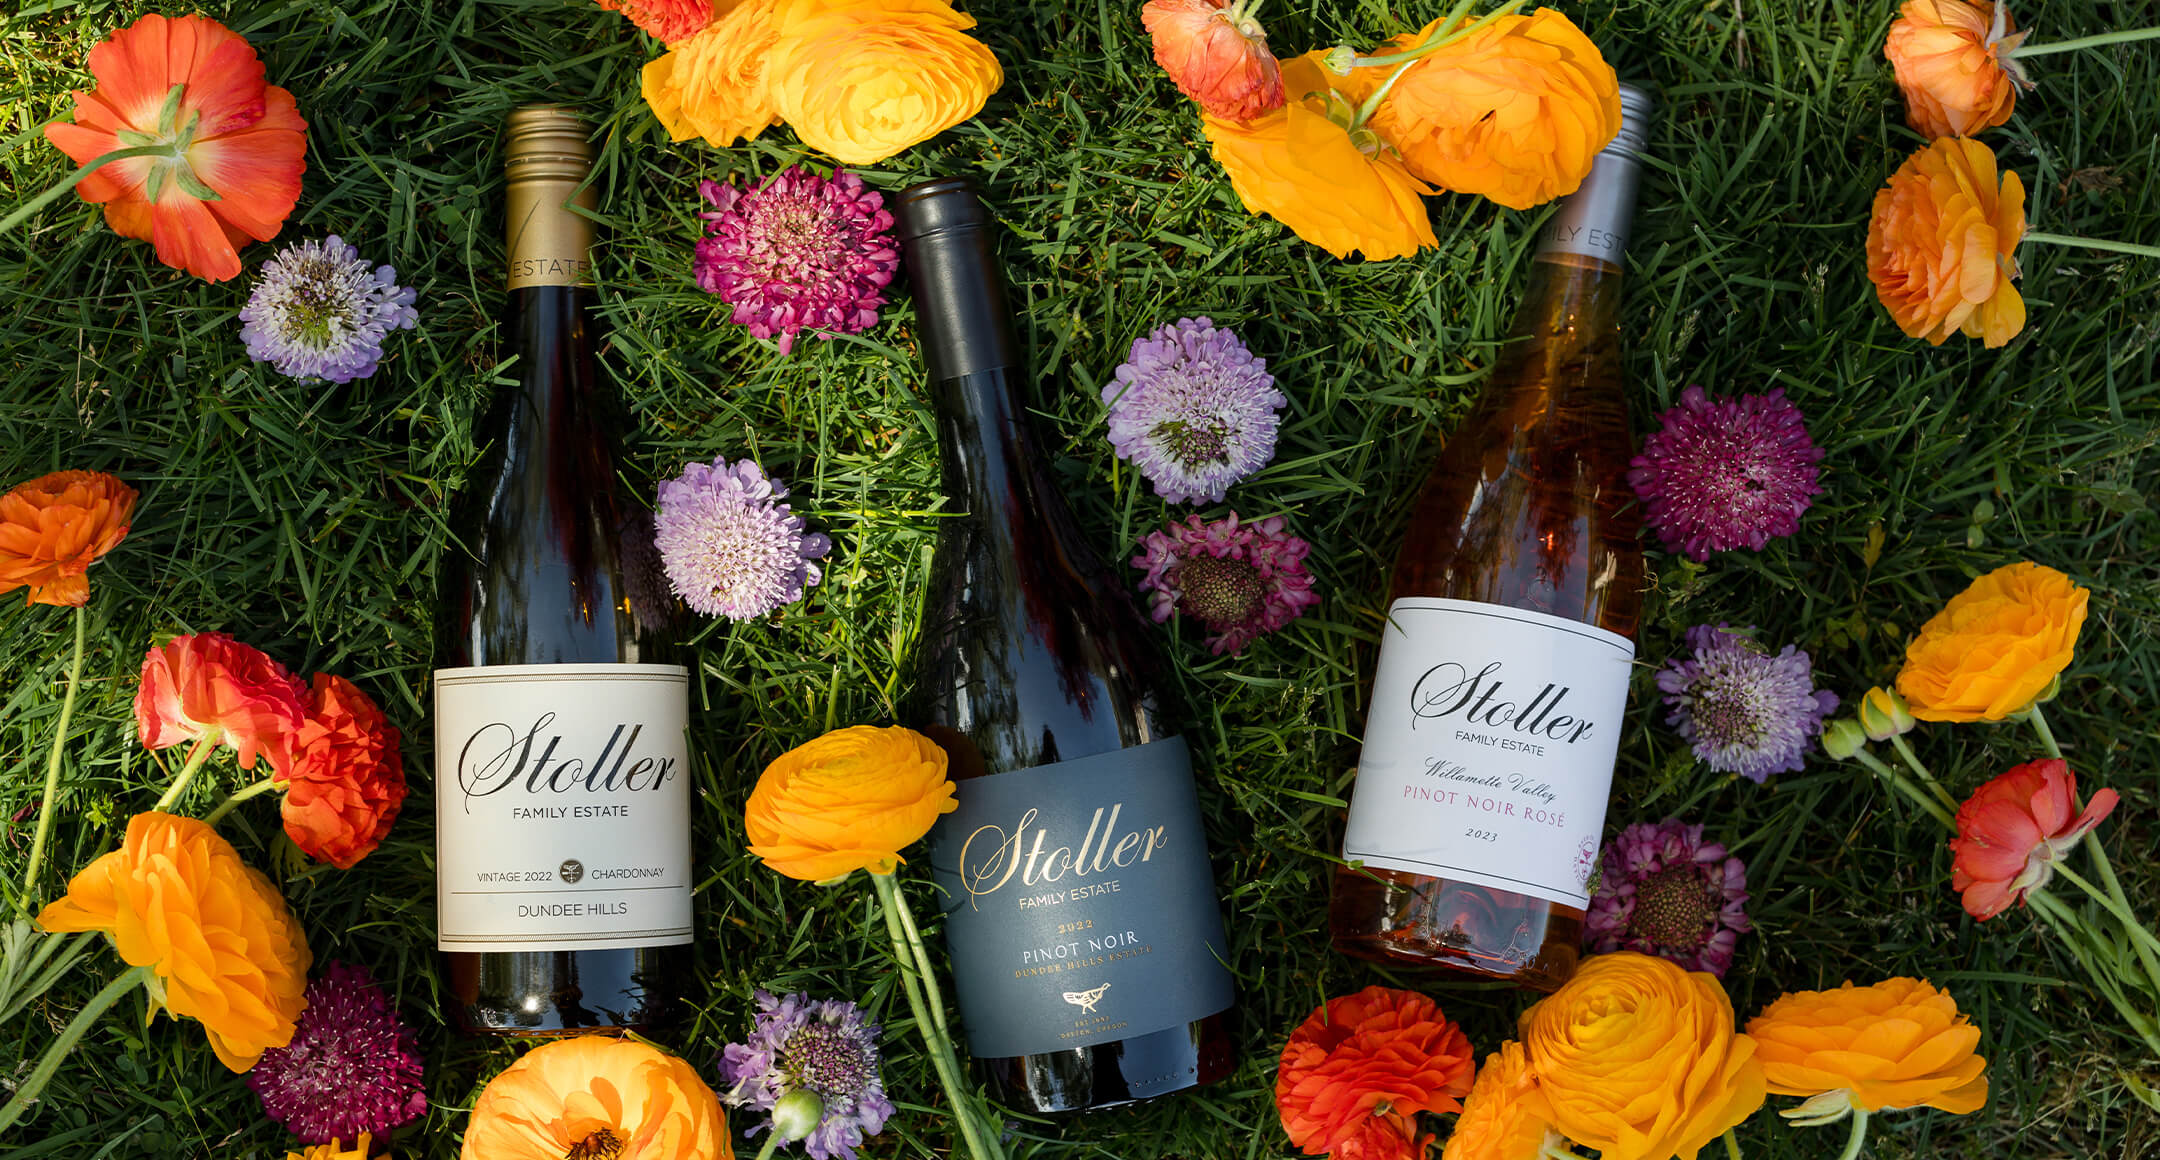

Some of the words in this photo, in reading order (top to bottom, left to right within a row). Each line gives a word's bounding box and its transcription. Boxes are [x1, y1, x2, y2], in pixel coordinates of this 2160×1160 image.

[1410, 661, 1593, 745] Stoller
[1455, 730, 1498, 750] FAMILY
[1502, 739, 1545, 757] ESTATE
[458, 711, 676, 815] Stoller
[1424, 755, 1503, 789] Willamette
[1507, 772, 1557, 805] Valley
[513, 806, 568, 819] FAMILY
[574, 805, 629, 818] ESTATE
[1403, 785, 1458, 805] PINOT
[1467, 794, 1515, 817] NOIR
[1524, 806, 1566, 828] ROSÉ
[1465, 827, 1499, 843] 2023
[591, 867, 665, 880] CHARDONNAY
[959, 802, 1168, 912] Stoller
[477, 871, 521, 883] VINTAGE
[524, 871, 552, 882] 2022
[518, 903, 583, 918] DUNDEE
[588, 902, 628, 916] HILLS
[1019, 891, 1066, 912] FAMILY
[1071, 879, 1121, 901] ESTATE
[1057, 919, 1094, 934] 2022
[1015, 963, 1062, 979] DUNDEE
[1067, 955, 1105, 971] HILLS
[1109, 945, 1153, 961] ESTATE
[1023, 942, 1080, 964] PINOT
[1088, 930, 1139, 952] NOIR
